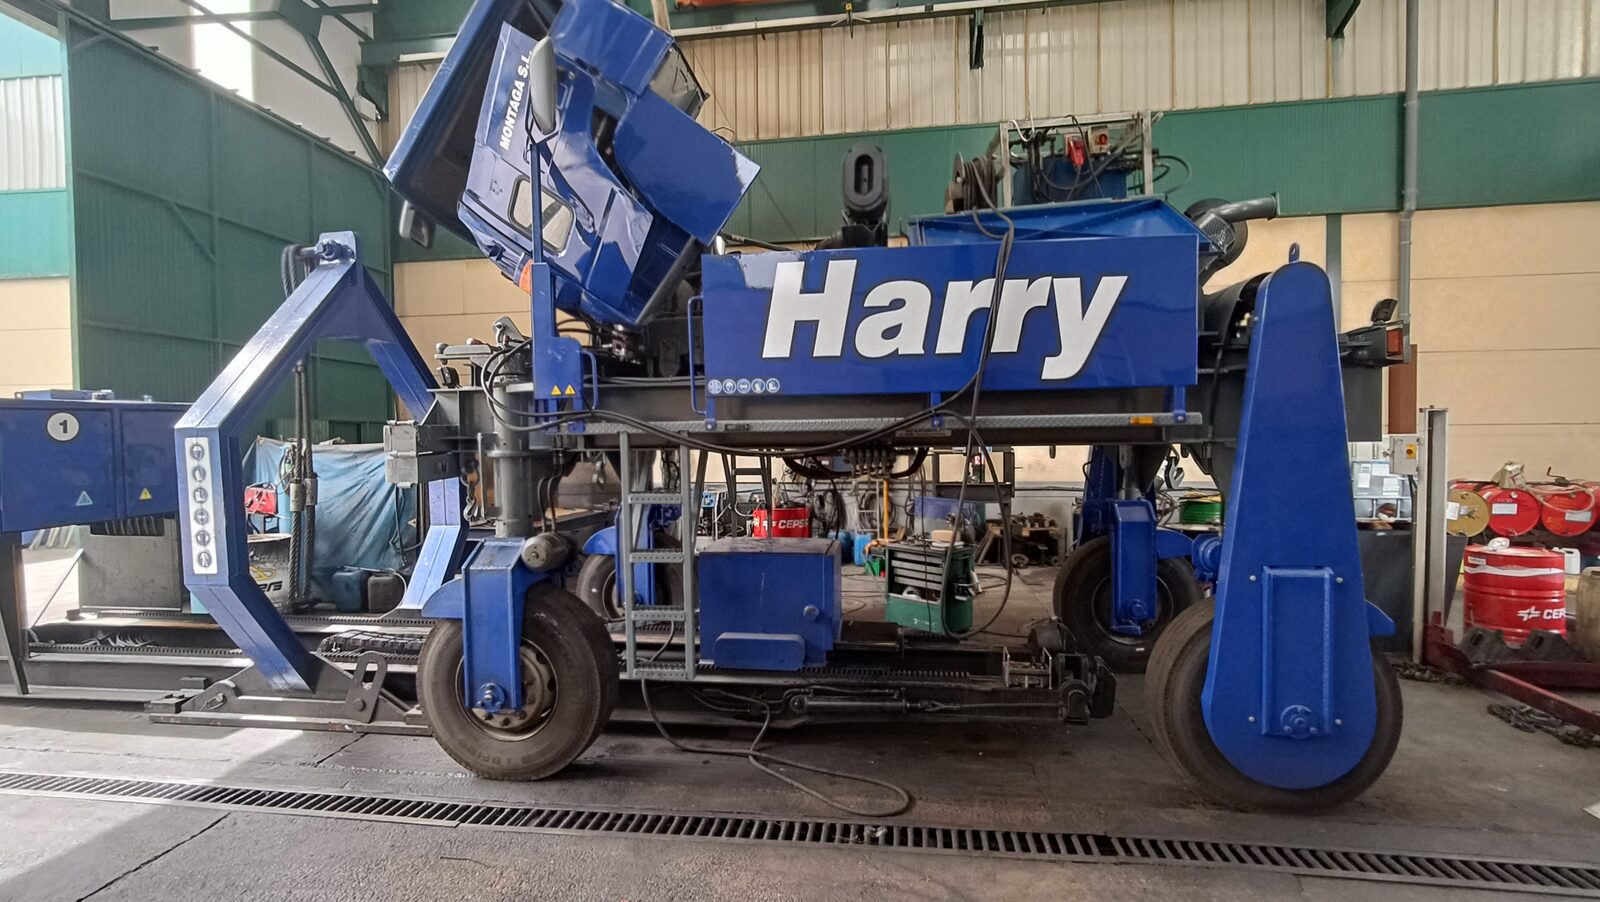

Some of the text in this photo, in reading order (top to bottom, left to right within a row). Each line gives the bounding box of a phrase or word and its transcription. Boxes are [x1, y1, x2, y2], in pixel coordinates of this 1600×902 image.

[499, 50, 532, 151] MONTAGA S.L.
[761, 258, 1129, 381] Harry
[59, 419, 68, 434] 1
